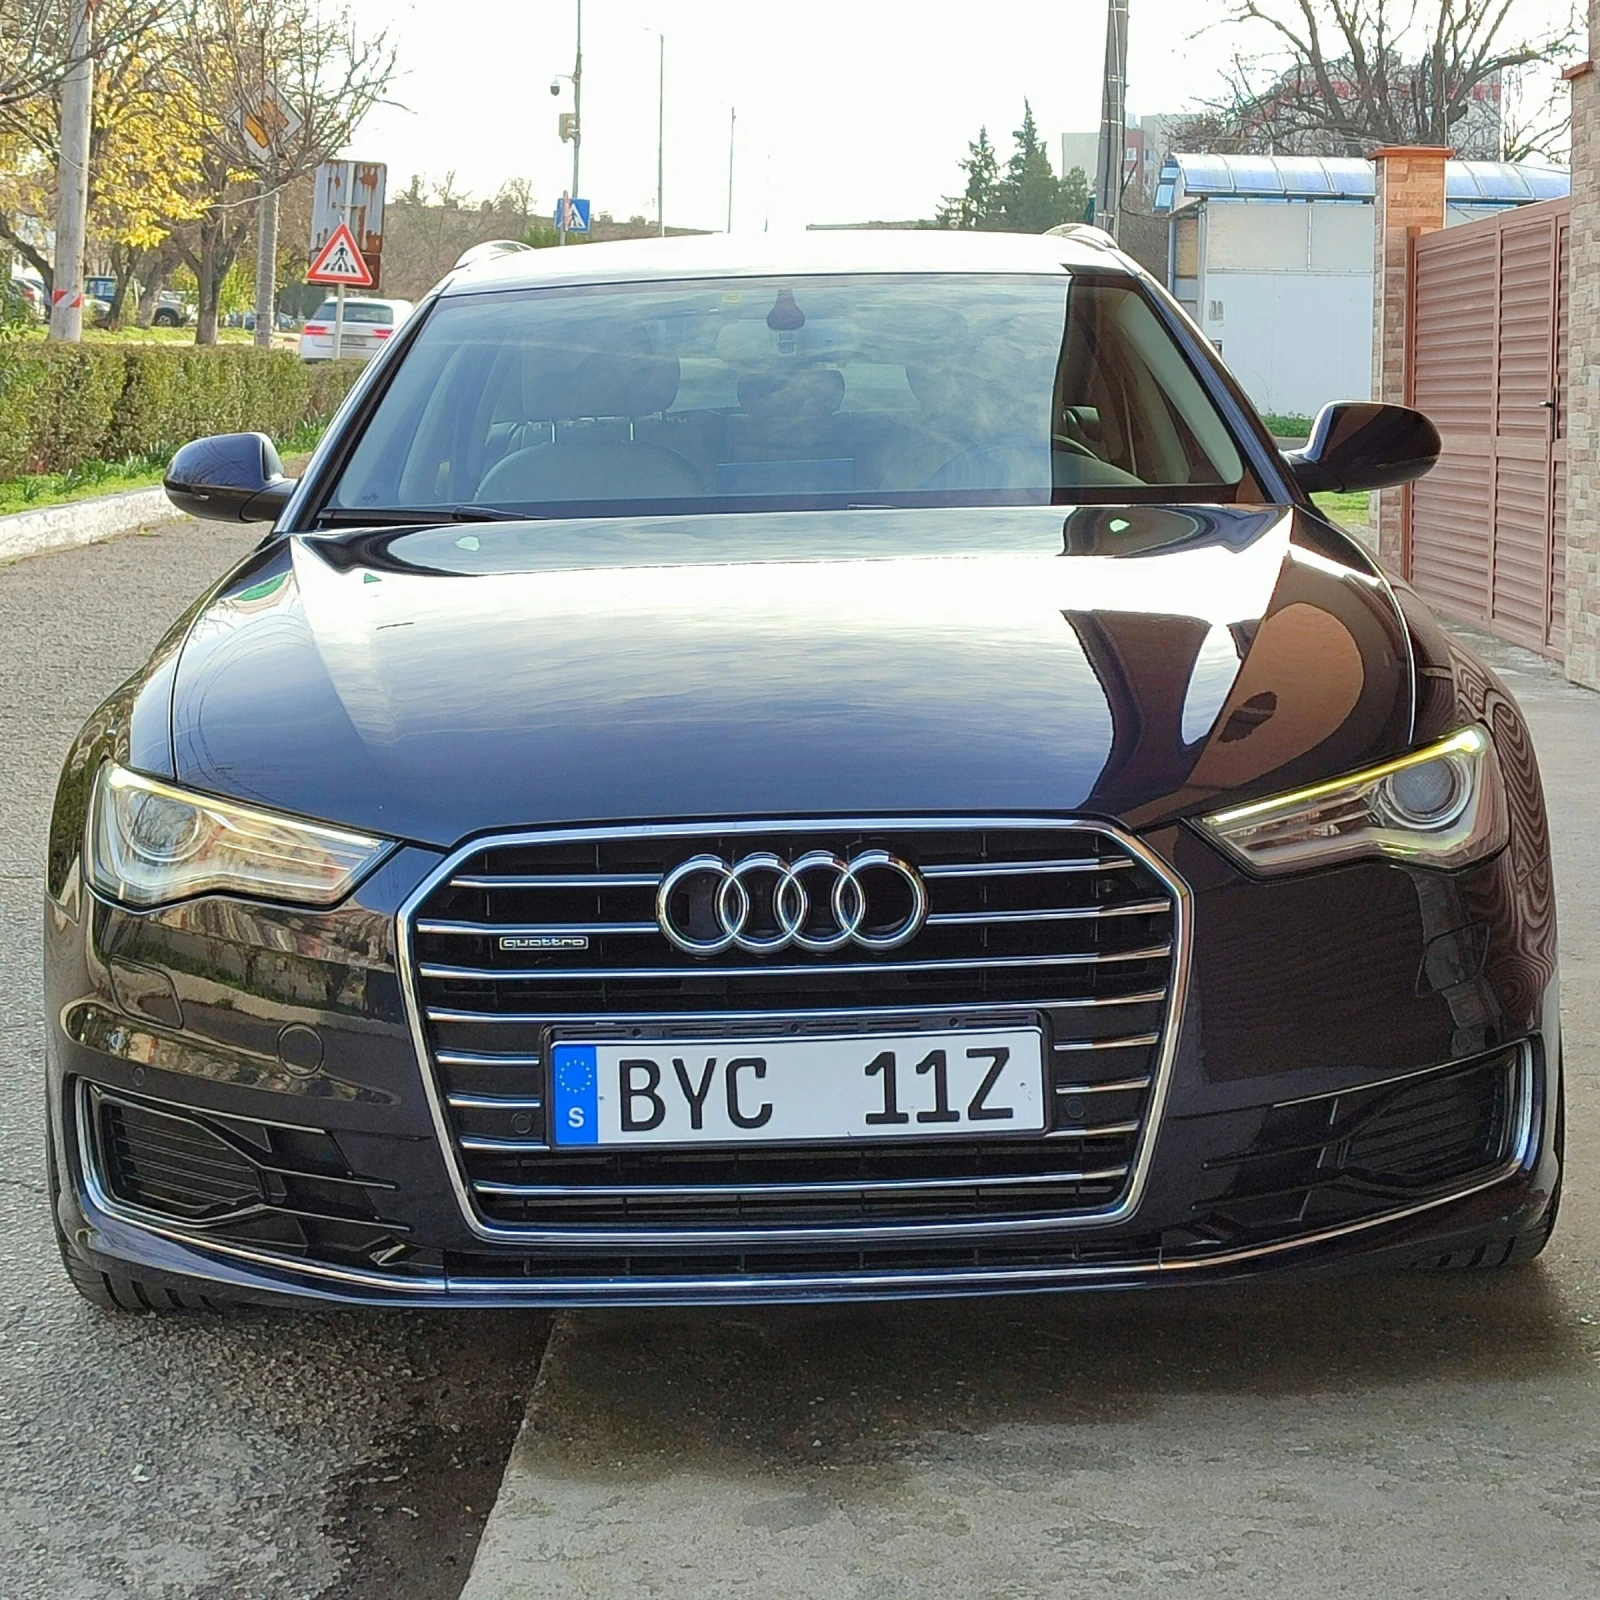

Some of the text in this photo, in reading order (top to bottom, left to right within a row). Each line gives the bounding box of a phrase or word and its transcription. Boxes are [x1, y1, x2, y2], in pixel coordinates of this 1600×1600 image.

[503, 938, 585, 948] quattro
[618, 1046, 1014, 1132] BYC 11Z
[567, 1106, 585, 1128] S
